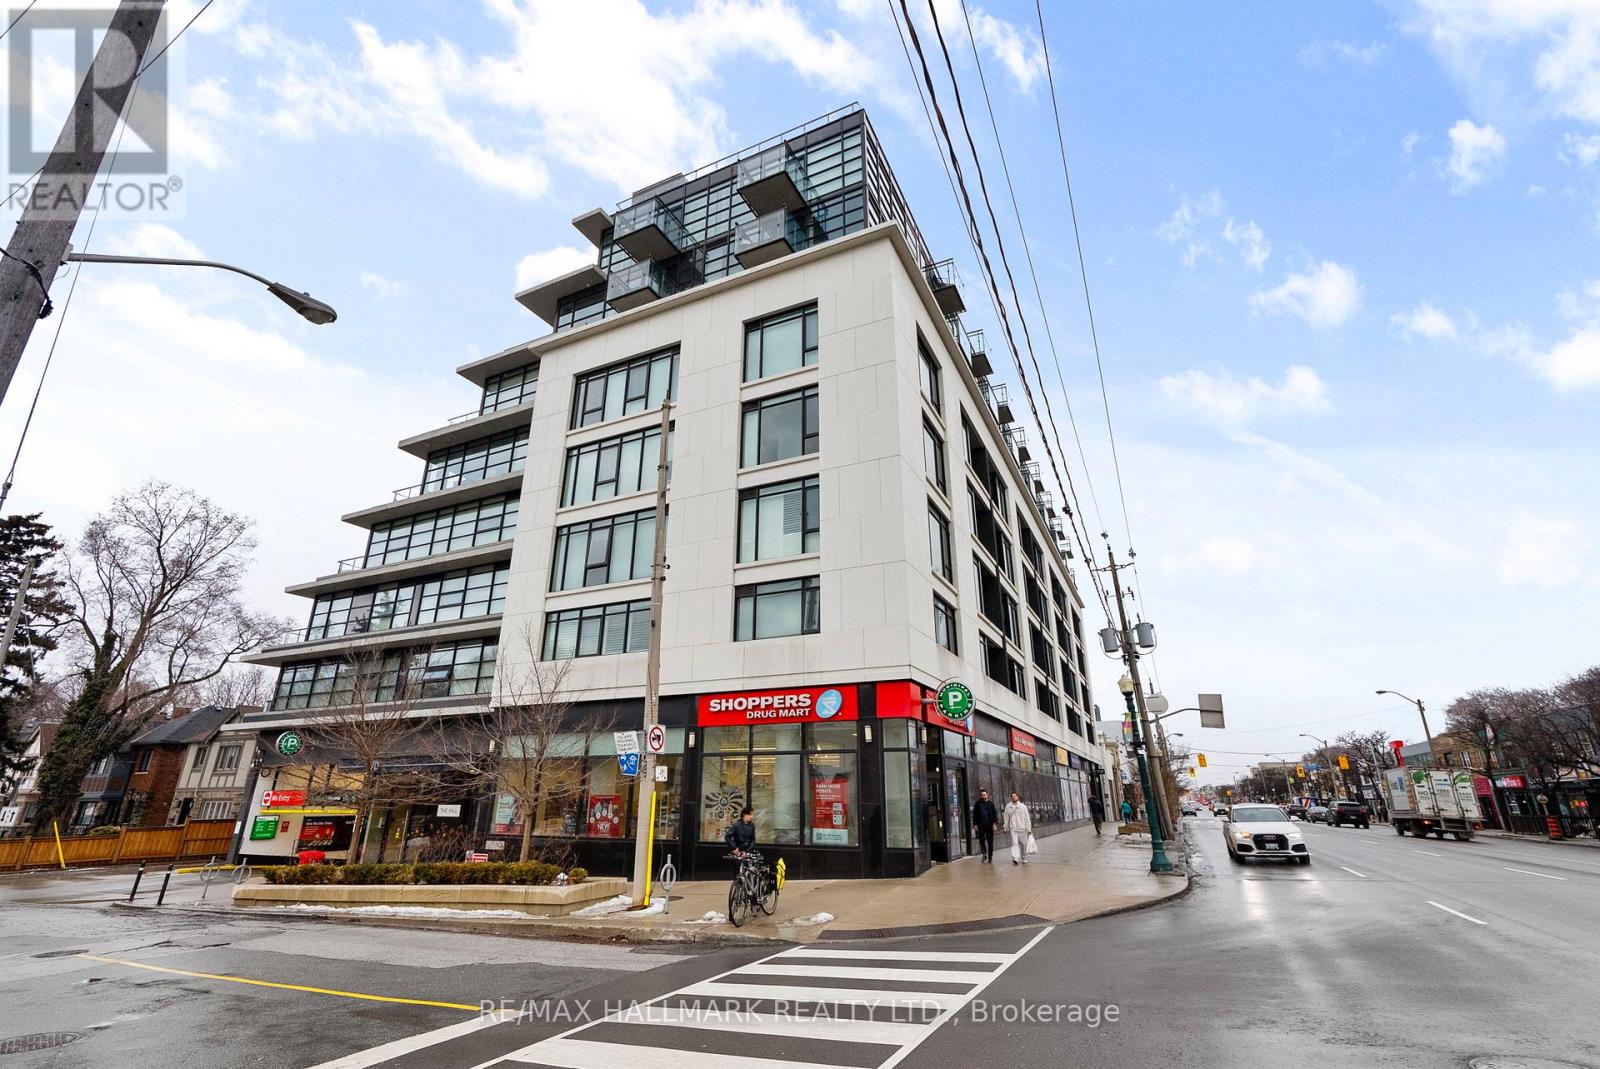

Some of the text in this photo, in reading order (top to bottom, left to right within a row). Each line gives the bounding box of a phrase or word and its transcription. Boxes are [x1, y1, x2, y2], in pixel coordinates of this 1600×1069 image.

[939, 683, 971, 698] MUNICIPAL
[709, 694, 811, 712] SHOPPERS
[948, 691, 963, 707] P
[746, 708, 811, 719] DRUG MART
